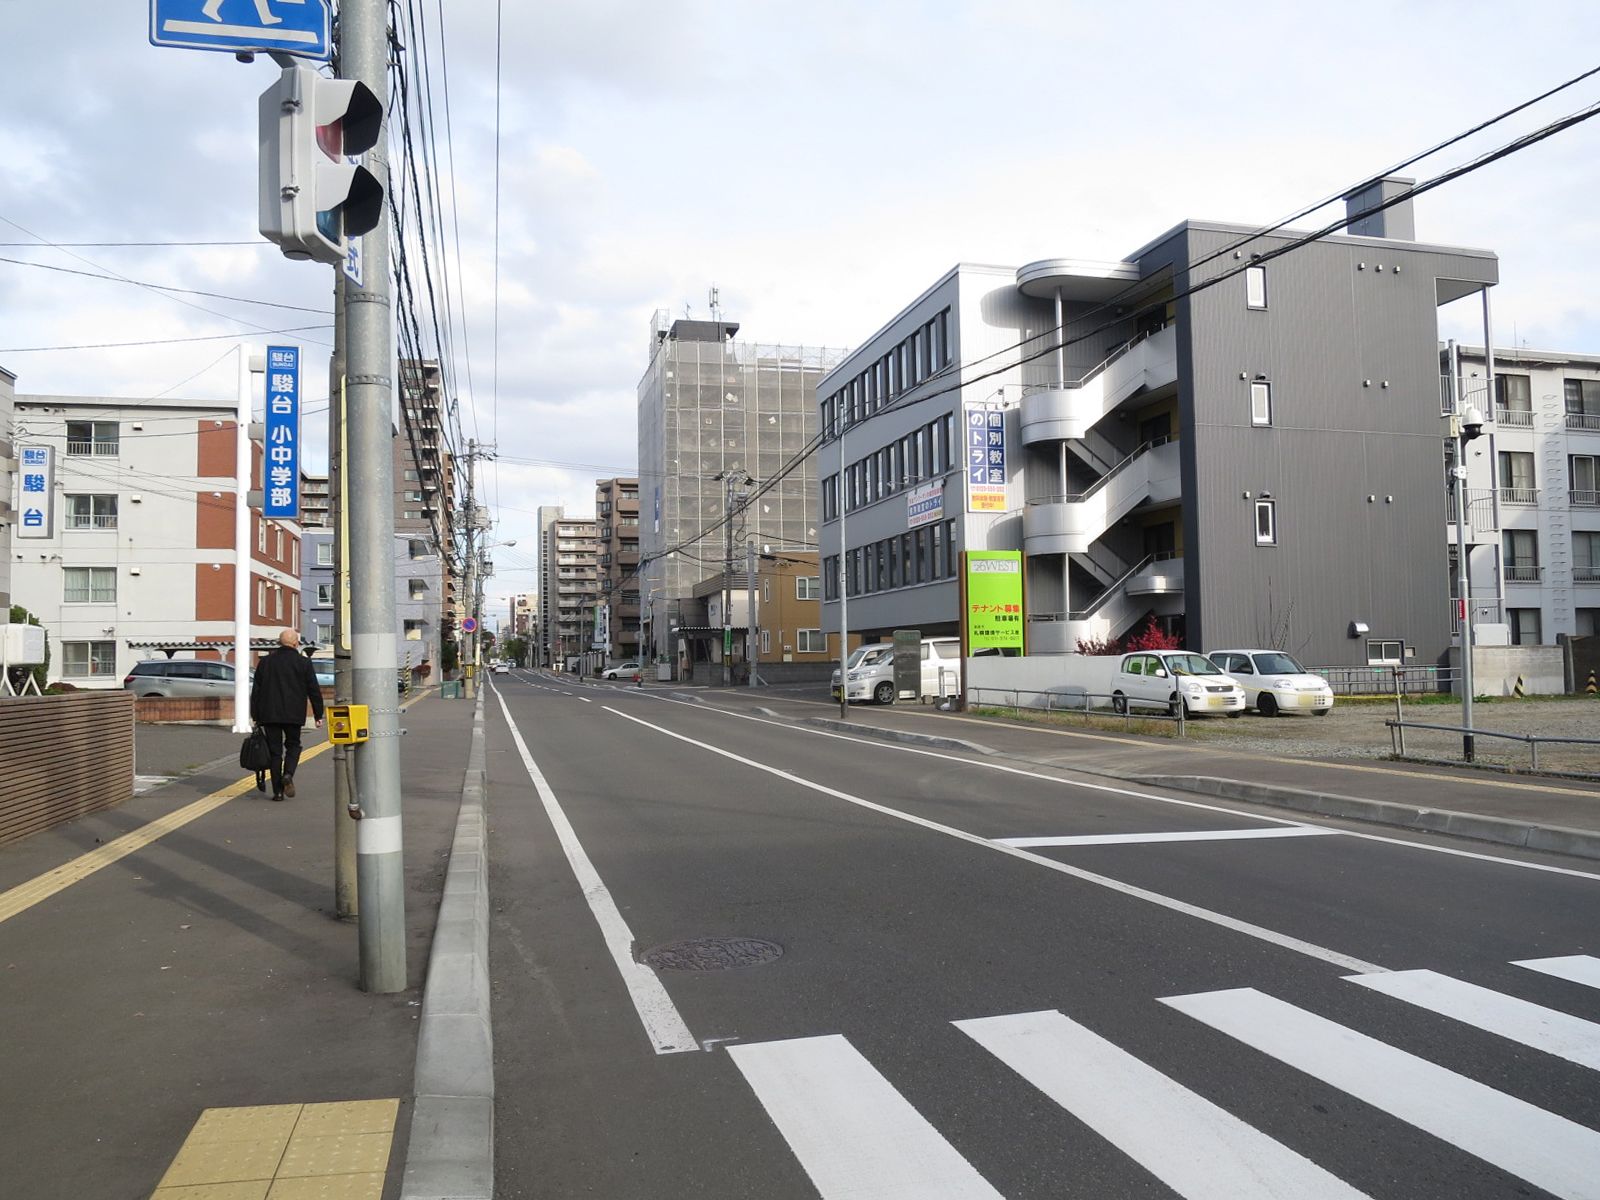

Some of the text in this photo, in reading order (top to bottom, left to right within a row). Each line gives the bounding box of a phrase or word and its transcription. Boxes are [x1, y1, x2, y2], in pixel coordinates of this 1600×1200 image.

[272, 352, 294, 362] 駿台
[24, 450, 46, 459] 駿台
[271, 374, 293, 507] 駿台 小中学部
[970, 413, 985, 483] のトライ
[988, 413, 1003, 483] 個別教室
[23, 474, 45, 527] 駿台
